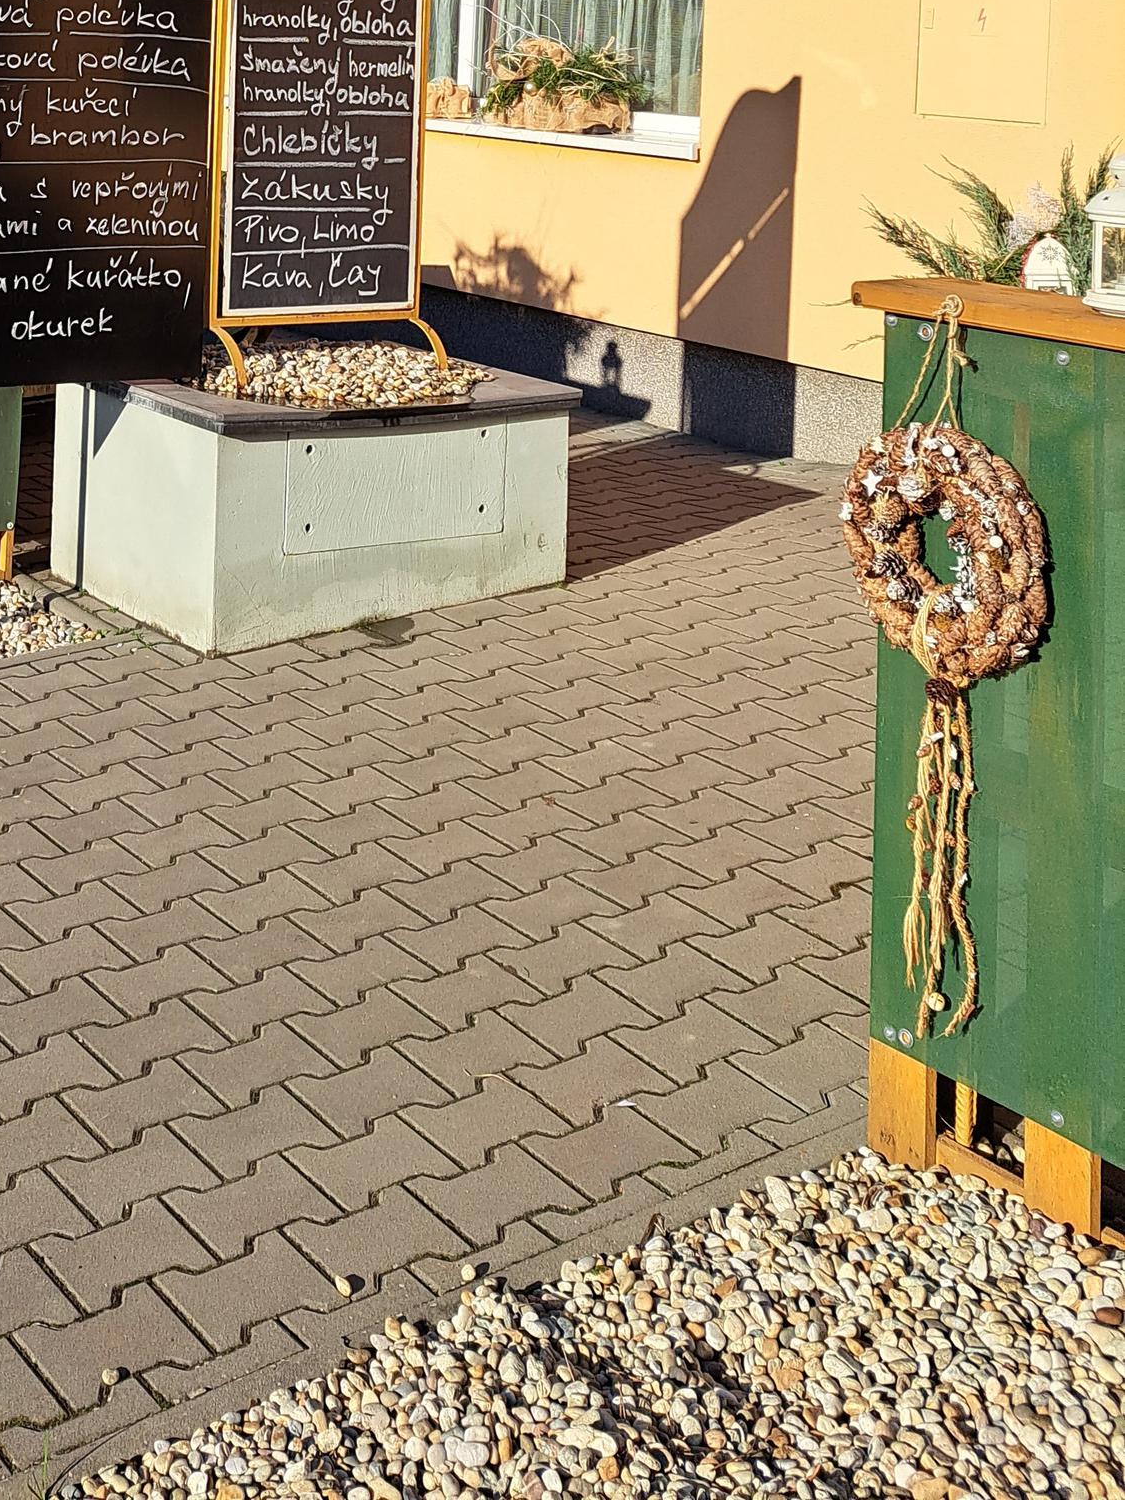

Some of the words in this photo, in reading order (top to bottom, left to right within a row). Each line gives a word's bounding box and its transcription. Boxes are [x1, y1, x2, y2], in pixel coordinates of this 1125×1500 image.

[340, 10, 414, 38] obloha
[77, 42, 191, 82] polévka
[240, 44, 341, 95] Smažený
[349, 47, 415, 81] hermelín
[46, 86, 138, 117] kuřecí
[336, 84, 410, 110] obloha
[30, 121, 185, 146] brambor
[243, 119, 379, 171] Chlebíčky
[30, 177, 48, 199] s
[241, 170, 393, 226] Zákusky
[58, 217, 72, 231] a
[85, 214, 200, 241] zeleninou
[313, 213, 375, 242] Limo
[11, 308, 114, 340] okurek
